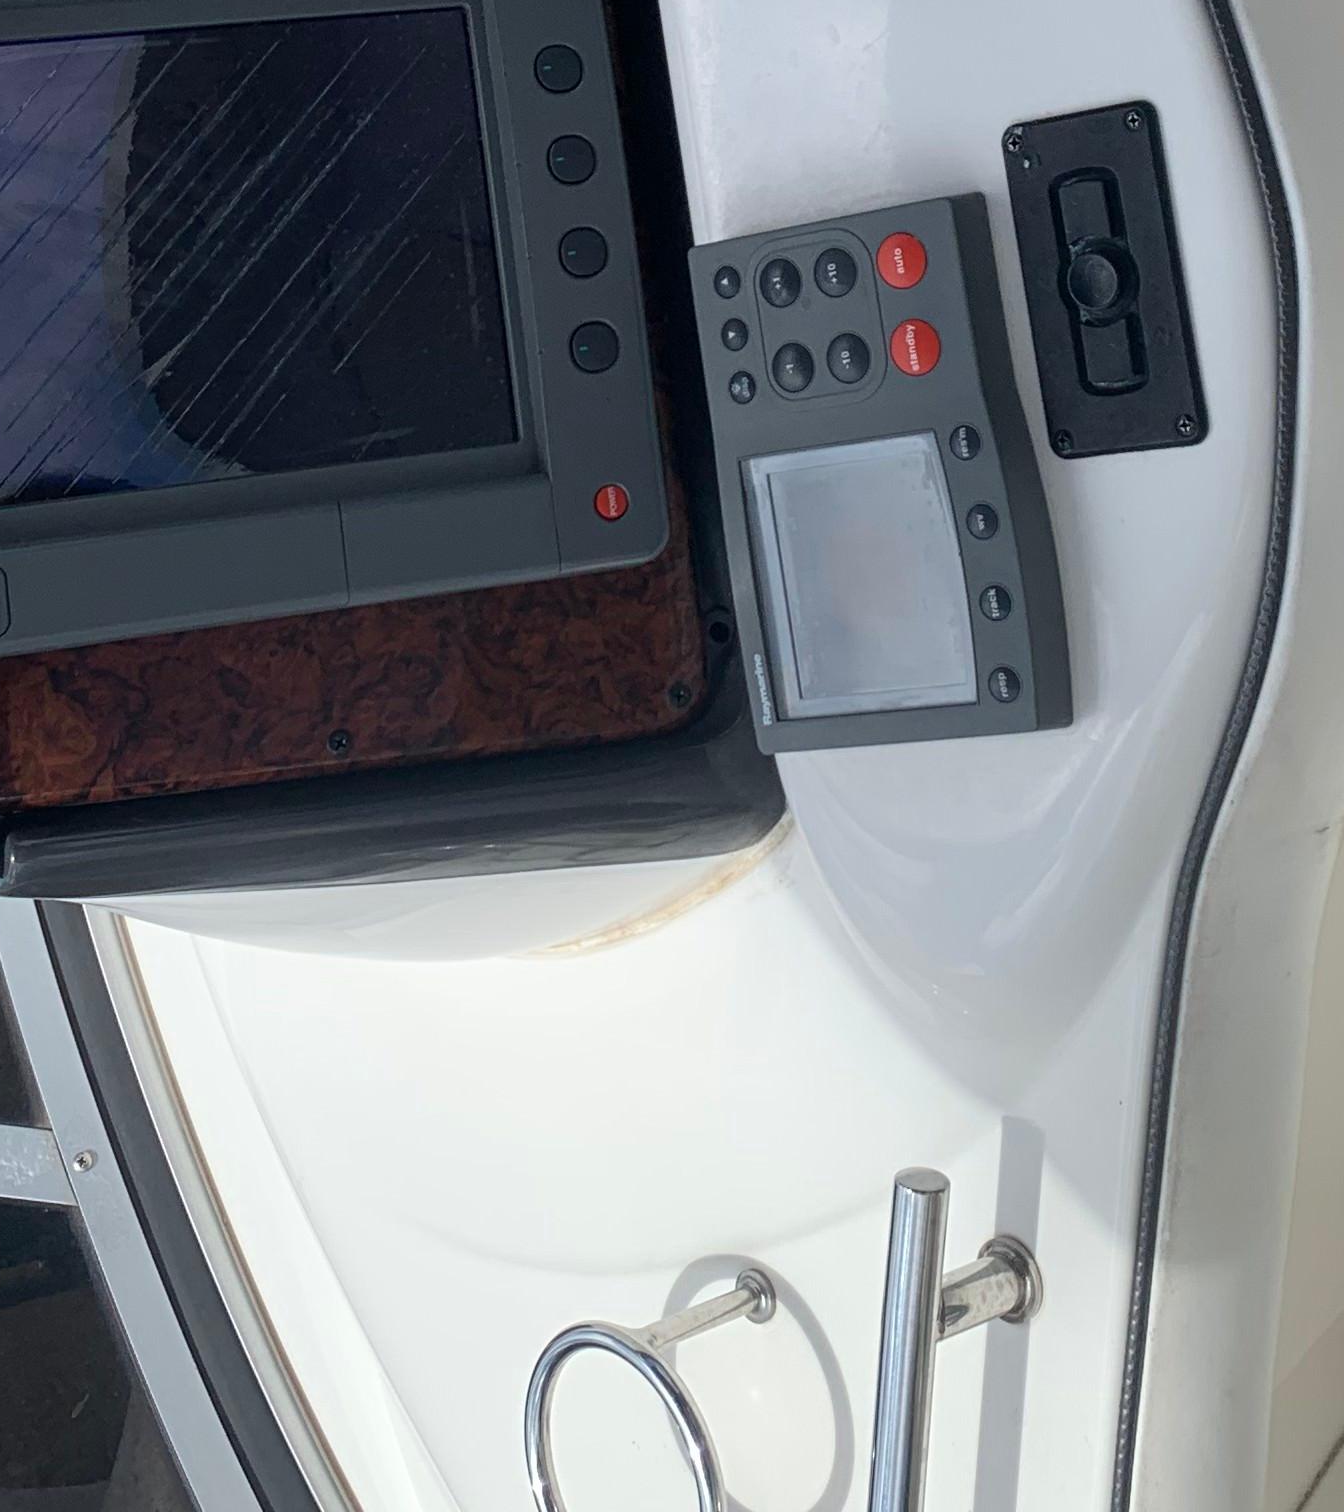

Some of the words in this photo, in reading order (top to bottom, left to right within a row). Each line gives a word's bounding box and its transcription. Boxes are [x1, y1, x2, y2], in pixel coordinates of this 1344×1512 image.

[827, 263, 838, 284] +10
[892, 247, 906, 275] auto
[771, 276, 782, 290] +1
[840, 350, 851, 369] -10
[904, 323, 921, 371] standby
[607, 486, 618, 517] POWER
[987, 588, 1000, 618] track
[754, 653, 773, 726] Raymarine
[997, 672, 1009, 698] resp
